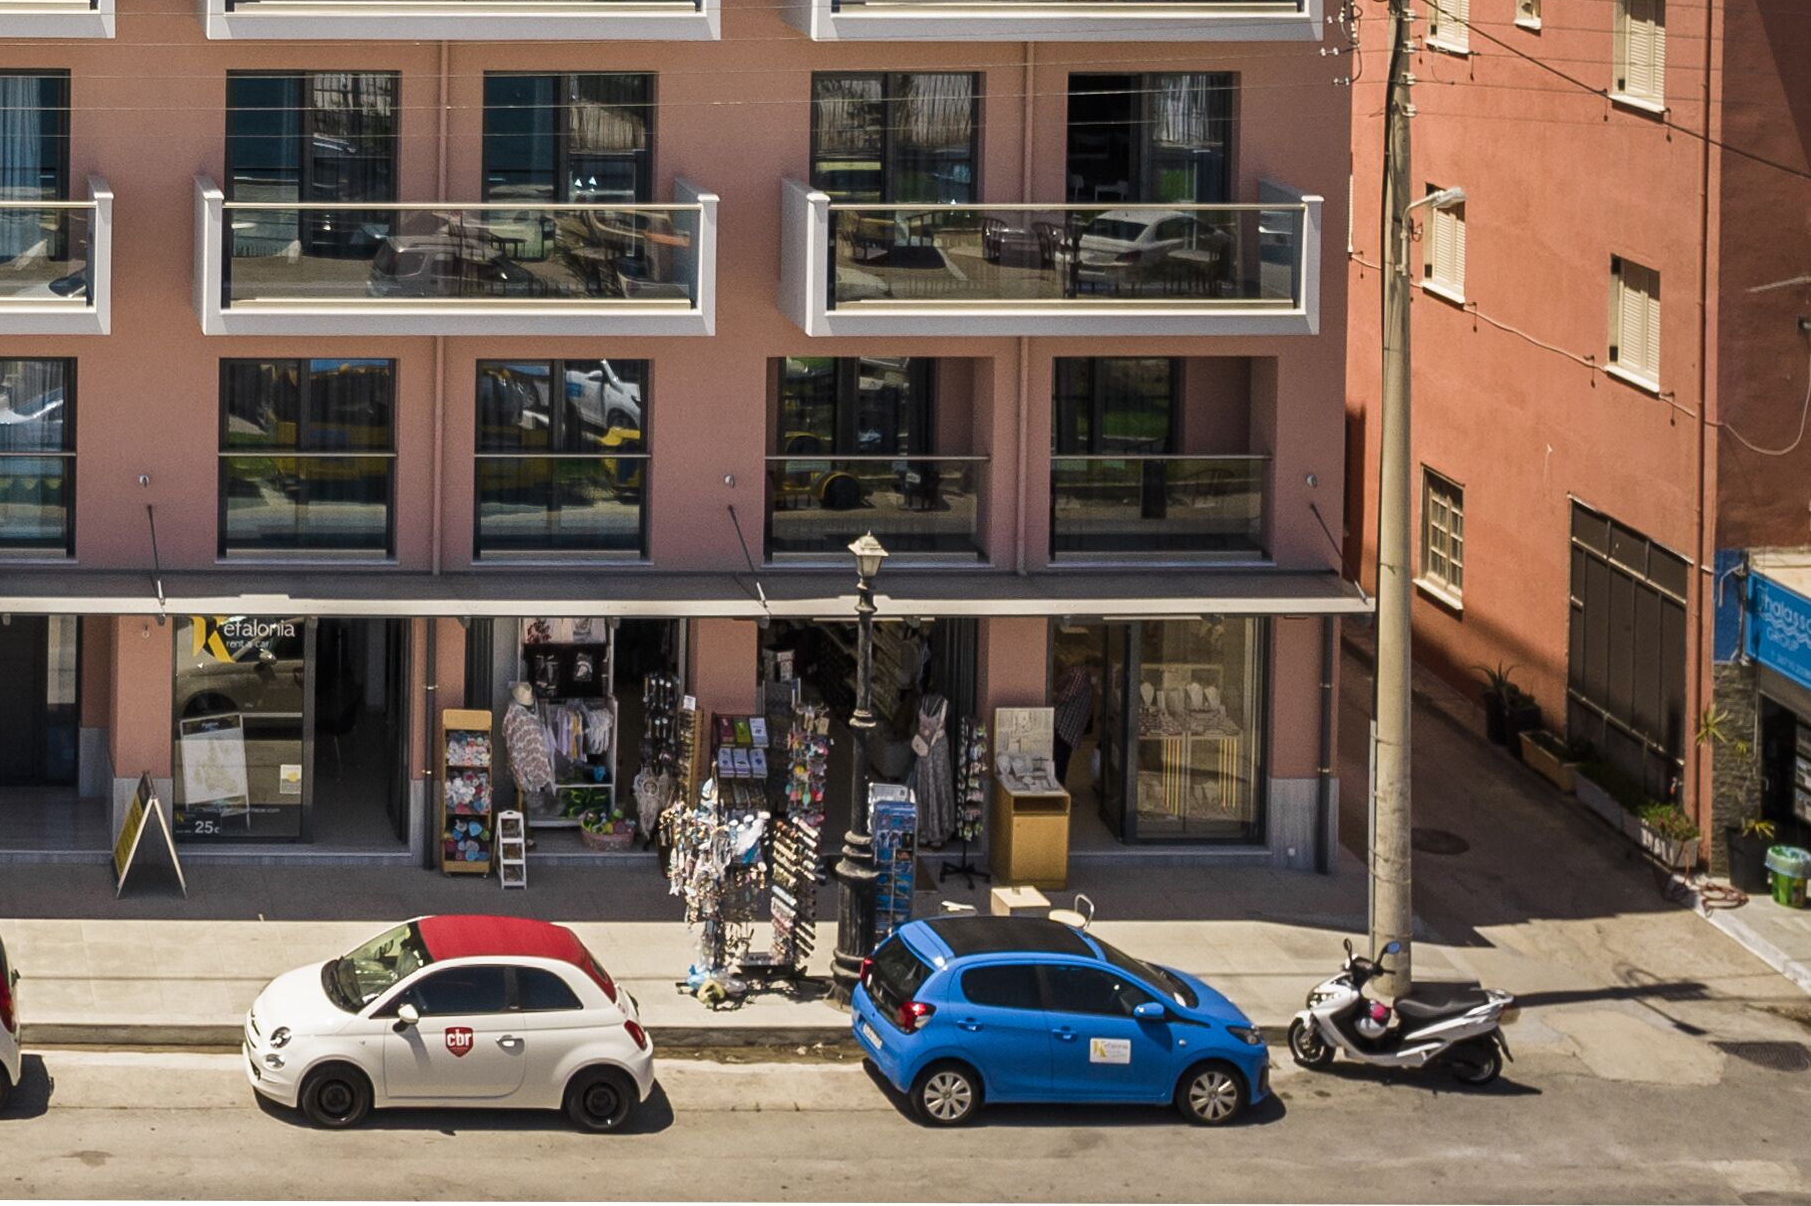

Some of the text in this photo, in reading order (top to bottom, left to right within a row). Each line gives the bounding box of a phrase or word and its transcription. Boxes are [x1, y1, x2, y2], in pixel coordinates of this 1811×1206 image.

[190, 615, 296, 663] Kefalonia
[255, 640, 270, 648] car
[447, 1029, 472, 1046] cbr
